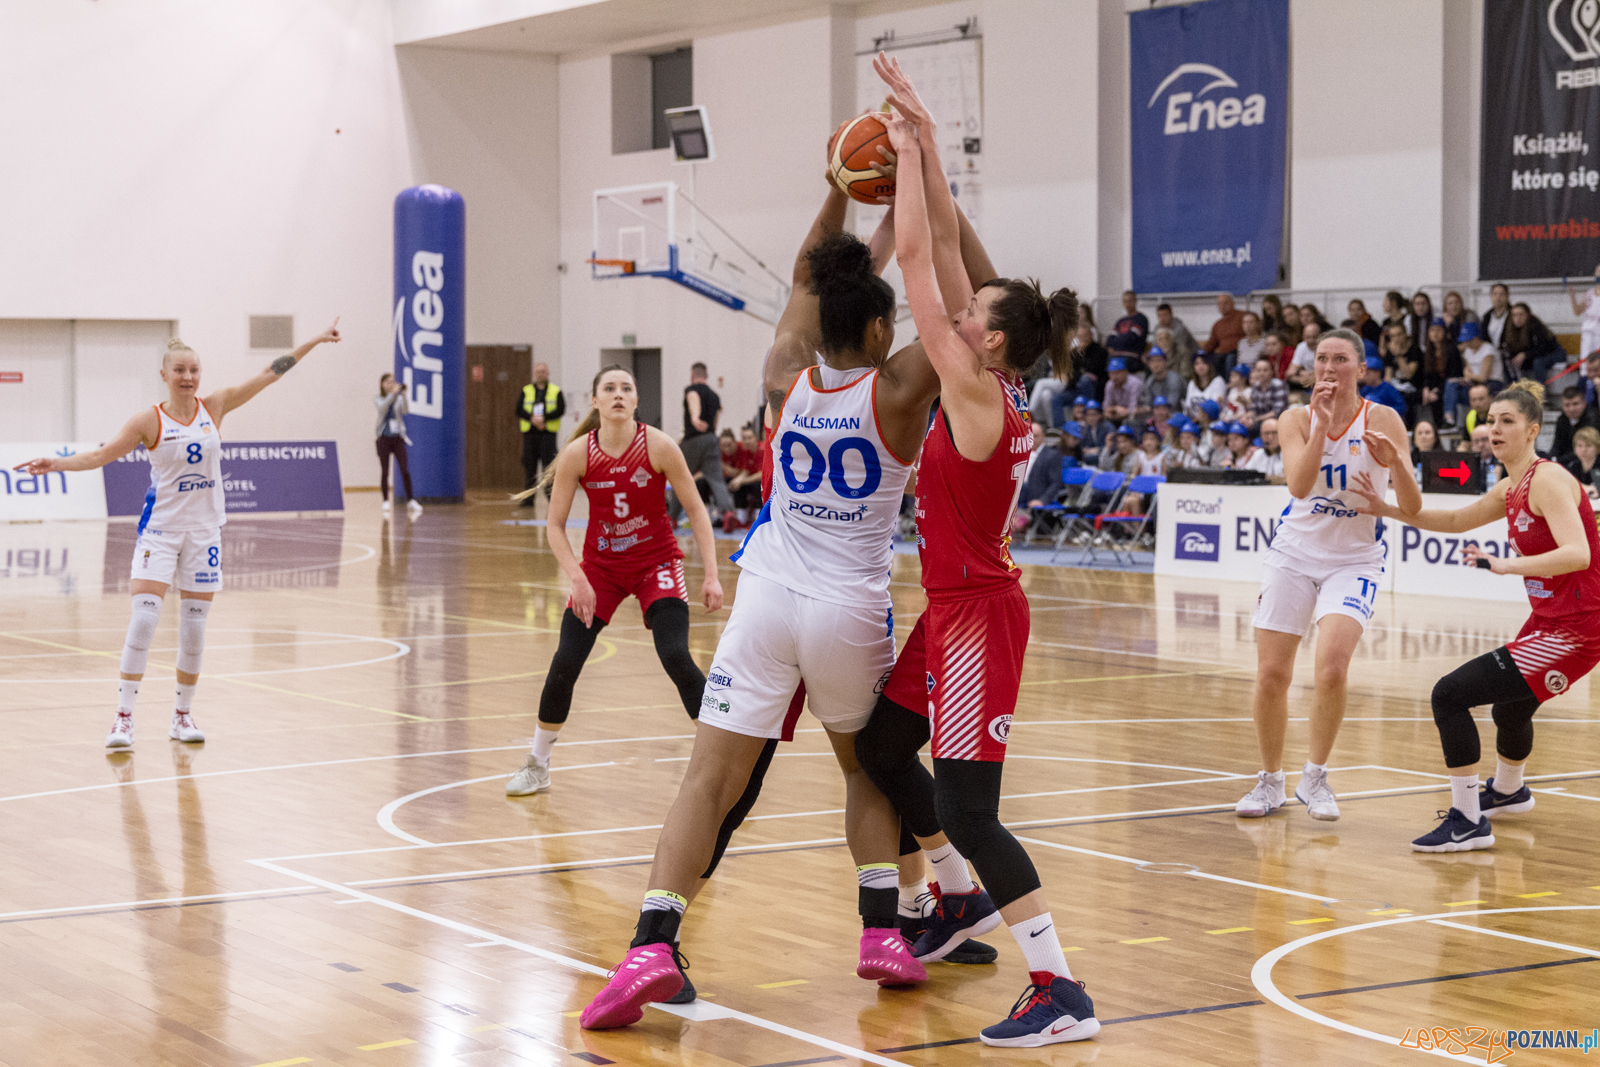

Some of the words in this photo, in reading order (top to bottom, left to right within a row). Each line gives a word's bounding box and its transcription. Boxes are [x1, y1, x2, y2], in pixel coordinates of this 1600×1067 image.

[1164, 91, 1267, 135] Enea
[1512, 131, 1589, 159] Książki,
[1511, 168, 1565, 191] które
[1568, 166, 1600, 192] się
[1161, 241, 1251, 269] www.enea.pl
[403, 250, 444, 419] Enea
[792, 414, 860, 430] HILLSMAN
[186, 443, 203, 465] 8
[779, 430, 882, 499] 00
[178, 479, 216, 493] Enea
[1320, 464, 1347, 491] 11
[613, 492, 630, 519] 5
[1311, 502, 1359, 518] Enea
[1183, 538, 1216, 554] Enea
[1236, 516, 1283, 552] EN
[208, 546, 219, 567] 8
[657, 570, 675, 590] 5
[1357, 577, 1377, 606] 11
[666, 891, 680, 901] XL
